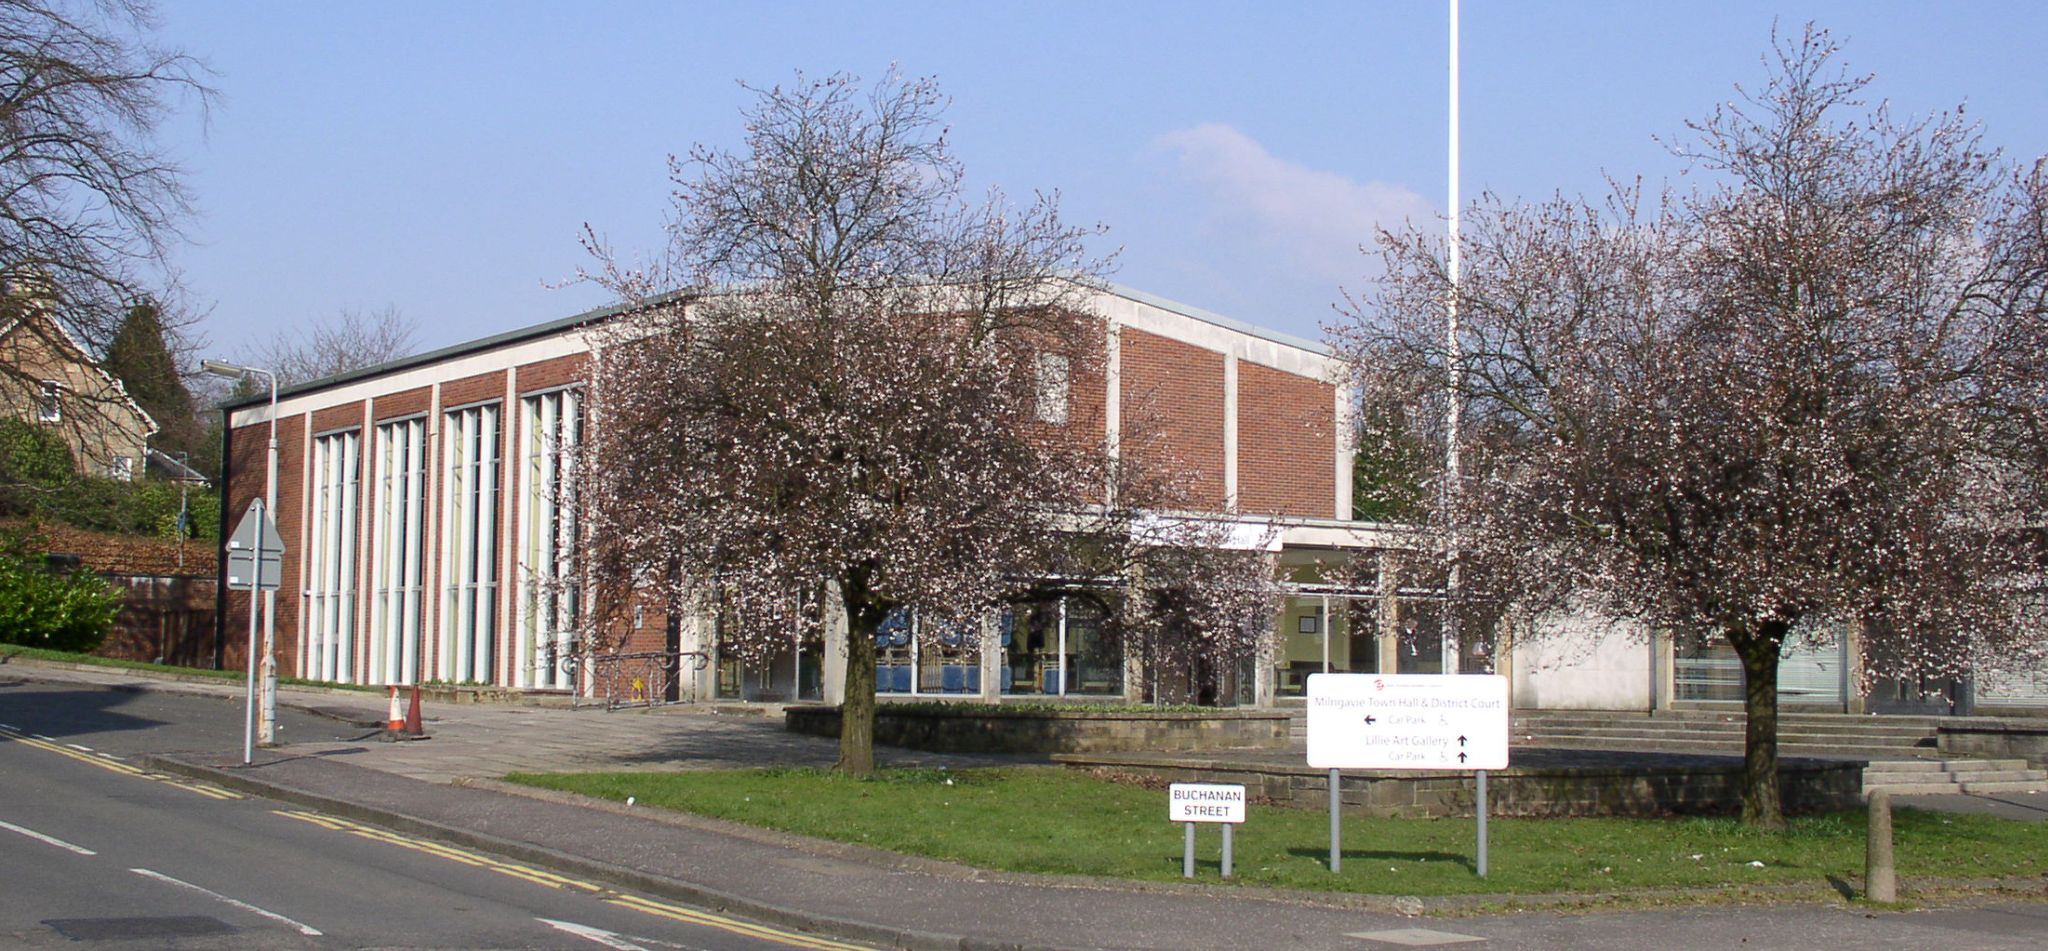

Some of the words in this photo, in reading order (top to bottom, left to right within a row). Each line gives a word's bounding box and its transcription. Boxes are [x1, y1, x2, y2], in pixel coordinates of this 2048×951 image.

[1315, 697, 1366, 709] Milngavie
[1368, 697, 1395, 707] Town
[1399, 698, 1418, 708] Hall
[1420, 698, 1428, 708] &
[1431, 698, 1468, 708] District
[1471, 698, 1500, 709] Court
[1388, 716, 1403, 724] Car
[1406, 715, 1426, 724] Park
[1366, 735, 1390, 745] Lillie
[1393, 736, 1409, 745] Art
[1412, 736, 1448, 748] Gallery
[1388, 752, 1403, 761] Car
[1406, 752, 1425, 760] Park
[1174, 790, 1241, 801] BUCHANAN
[1184, 805, 1230, 816] STREET
